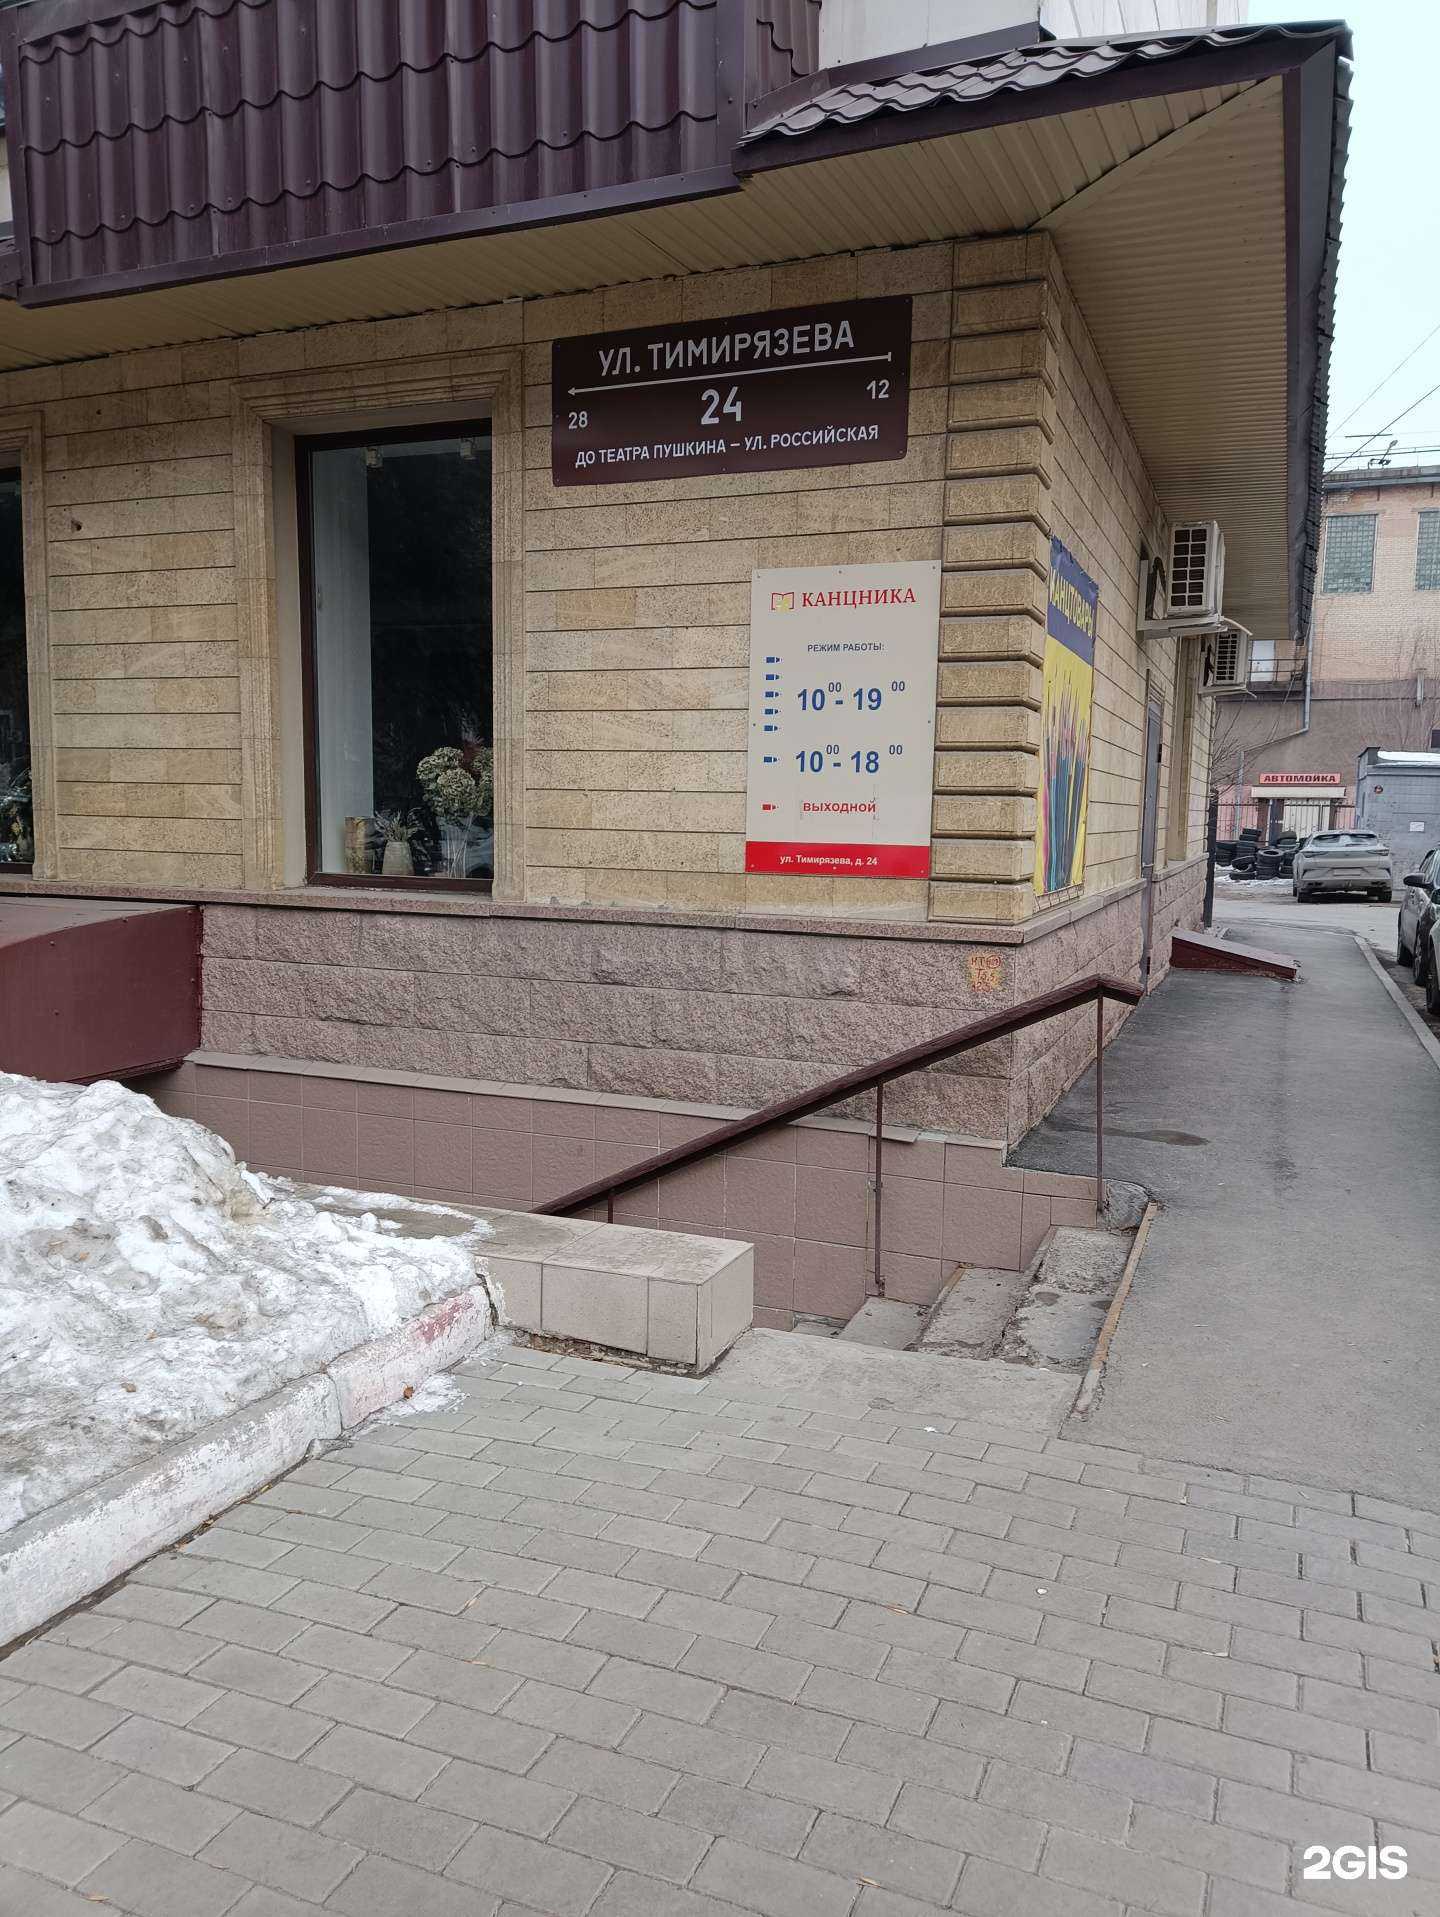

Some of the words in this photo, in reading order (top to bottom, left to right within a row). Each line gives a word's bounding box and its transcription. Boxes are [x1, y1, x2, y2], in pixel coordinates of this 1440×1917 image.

[598, 347, 641, 377] УЛ.
[648, 320, 855, 371] ТИМИРЯЗЕВА
[866, 379, 890, 400] 12
[700, 386, 743, 425] 24
[568, 411, 589, 430] 28
[575, 450, 596, 468] ДО
[599, 444, 650, 464] ТЕАТРА
[653, 439, 726, 459] ПУШКИНА
[744, 435, 768, 452] УЛ.
[770, 424, 880, 450] РОССИЙСКАЯ
[801, 587, 917, 609] КАНЦНИКА
[807, 643, 841, 652] РЕЖИМ
[843, 642, 885, 652] РАБОТЫ:
[1264, 773, 1336, 783] АВТОМОЙКА
[779, 855, 794, 864] ул.
[795, 854, 853, 866] Тимирязева,
[854, 857, 864, 866] д.
[866, 856, 878, 866] 24
